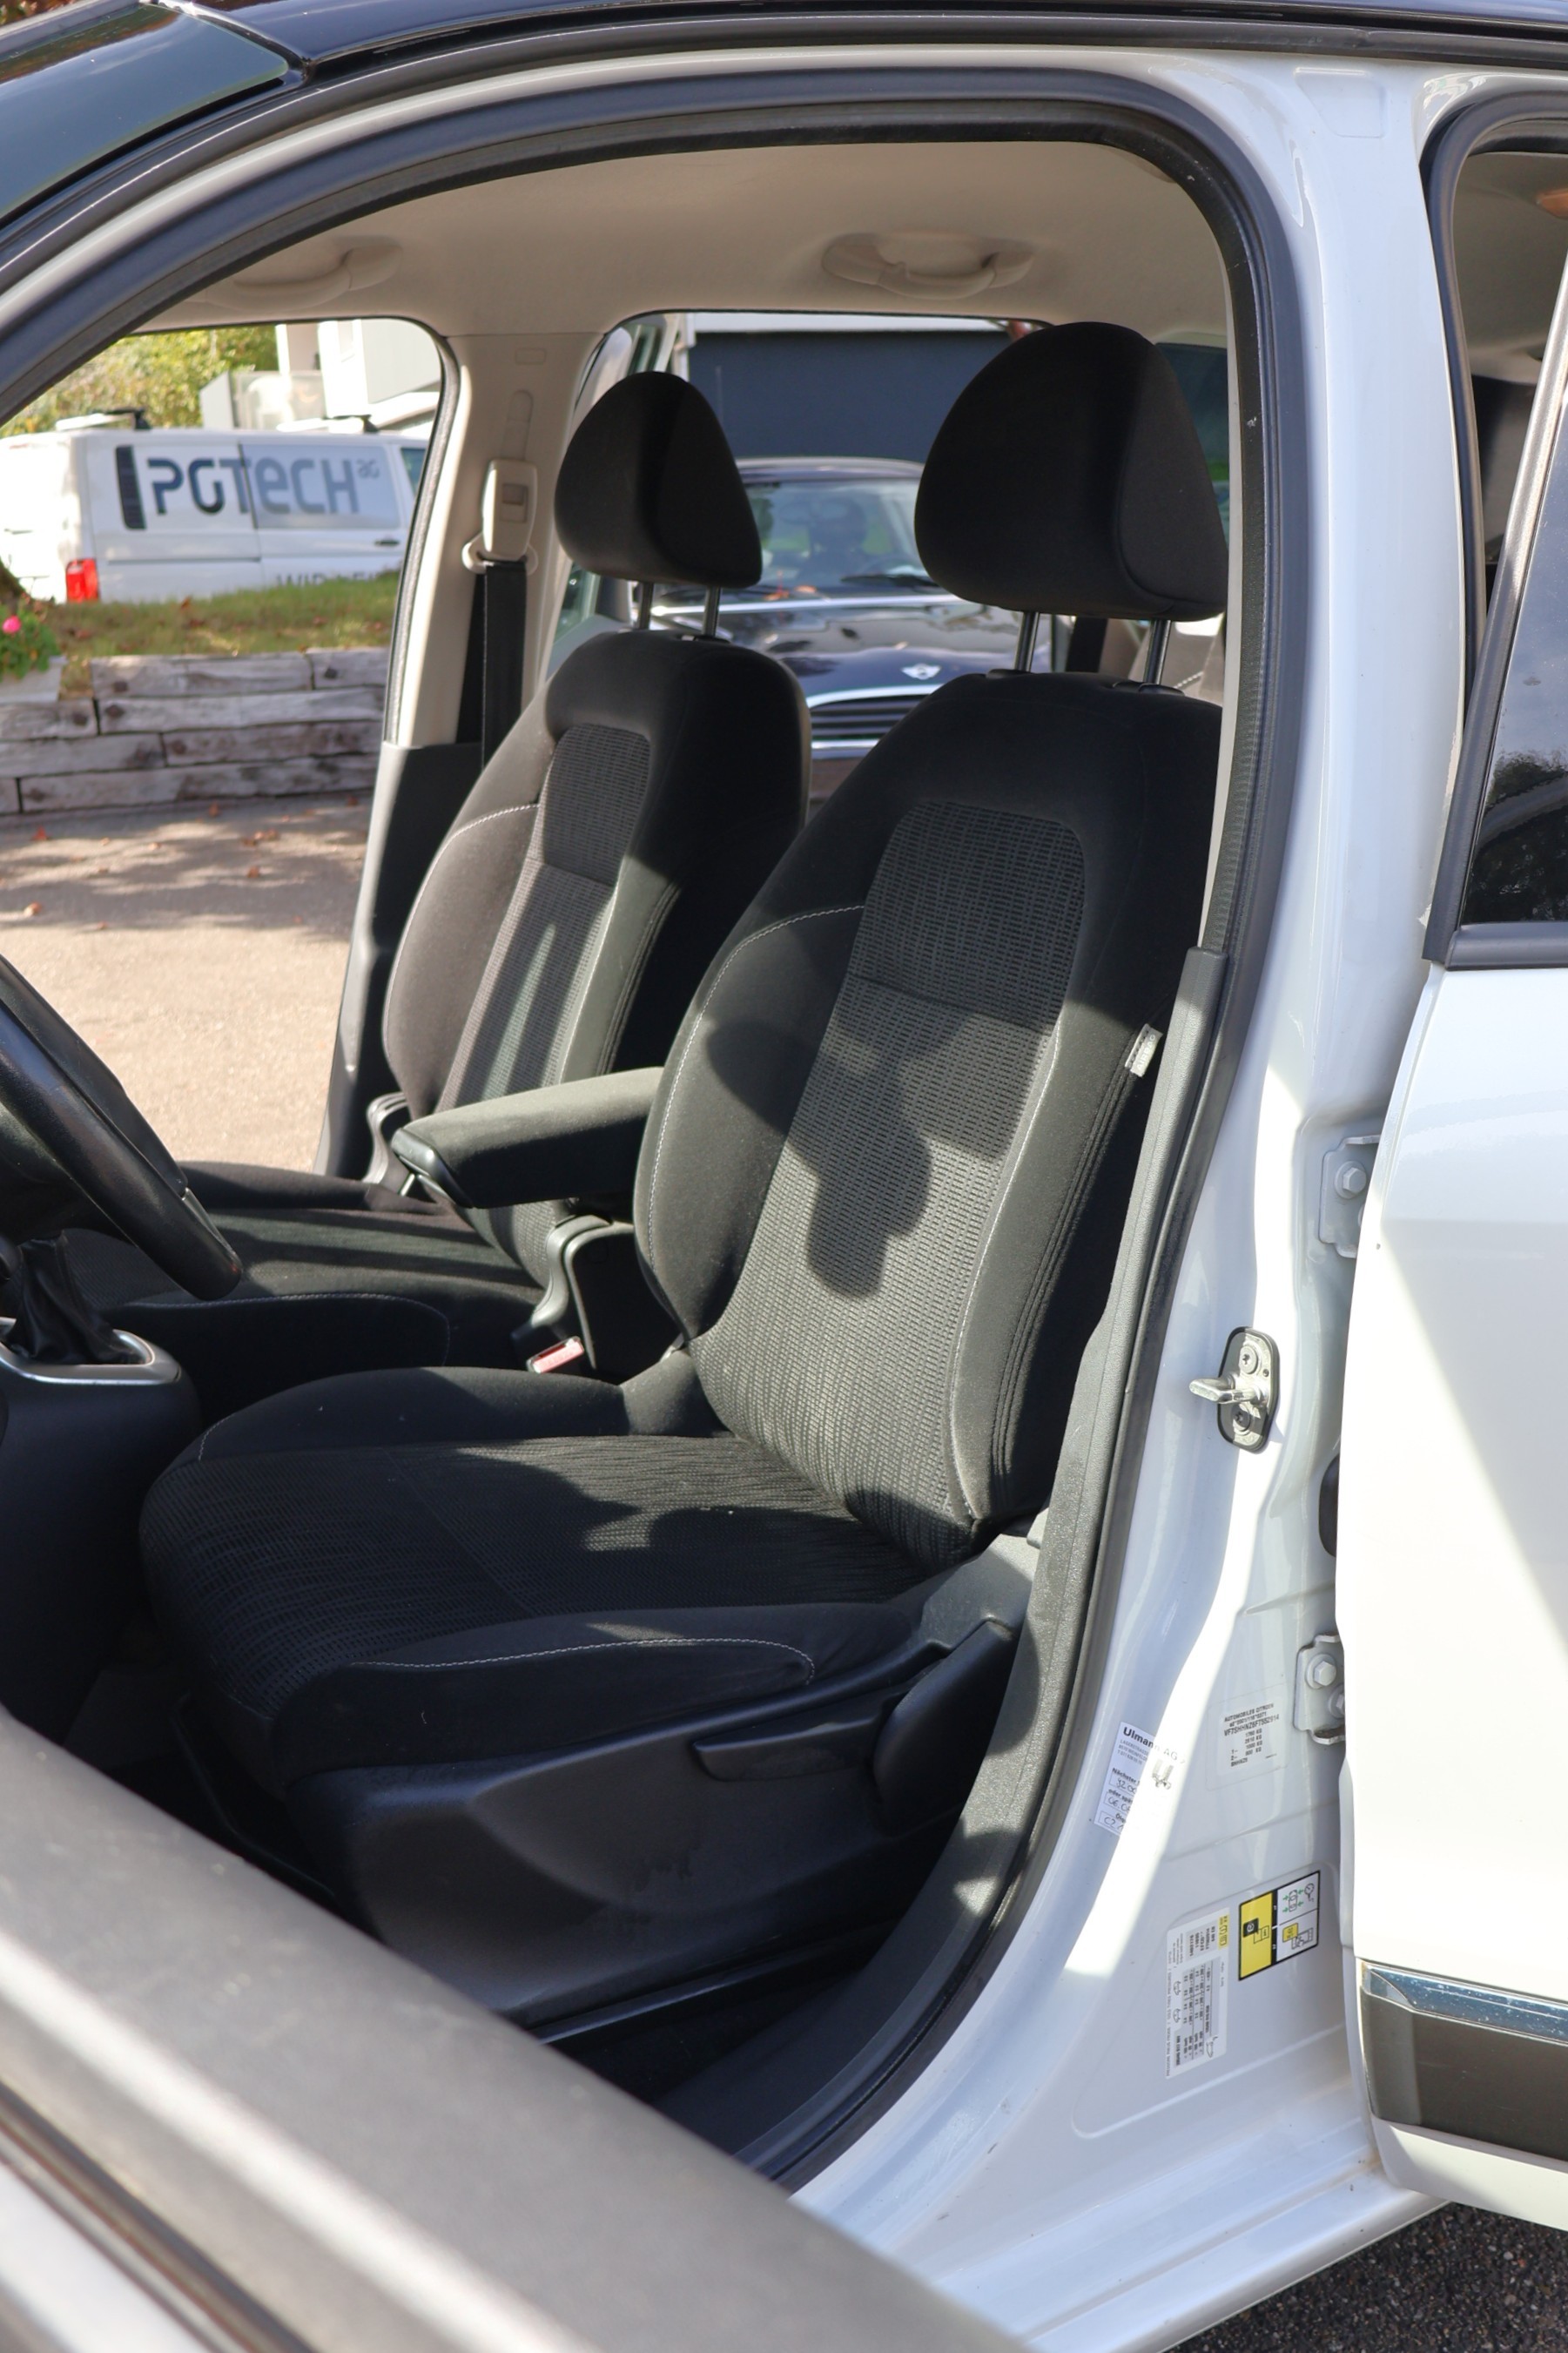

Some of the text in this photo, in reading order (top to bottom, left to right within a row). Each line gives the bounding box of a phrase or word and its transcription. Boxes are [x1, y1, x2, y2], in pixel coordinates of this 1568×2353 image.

[1136, 1034, 1156, 1070] AIRBAG
[1224, 1709, 1255, 1723] AUTOMOBILES
[1163, 1748, 1178, 1761] AG
[1107, 1789, 1121, 1797] oder
